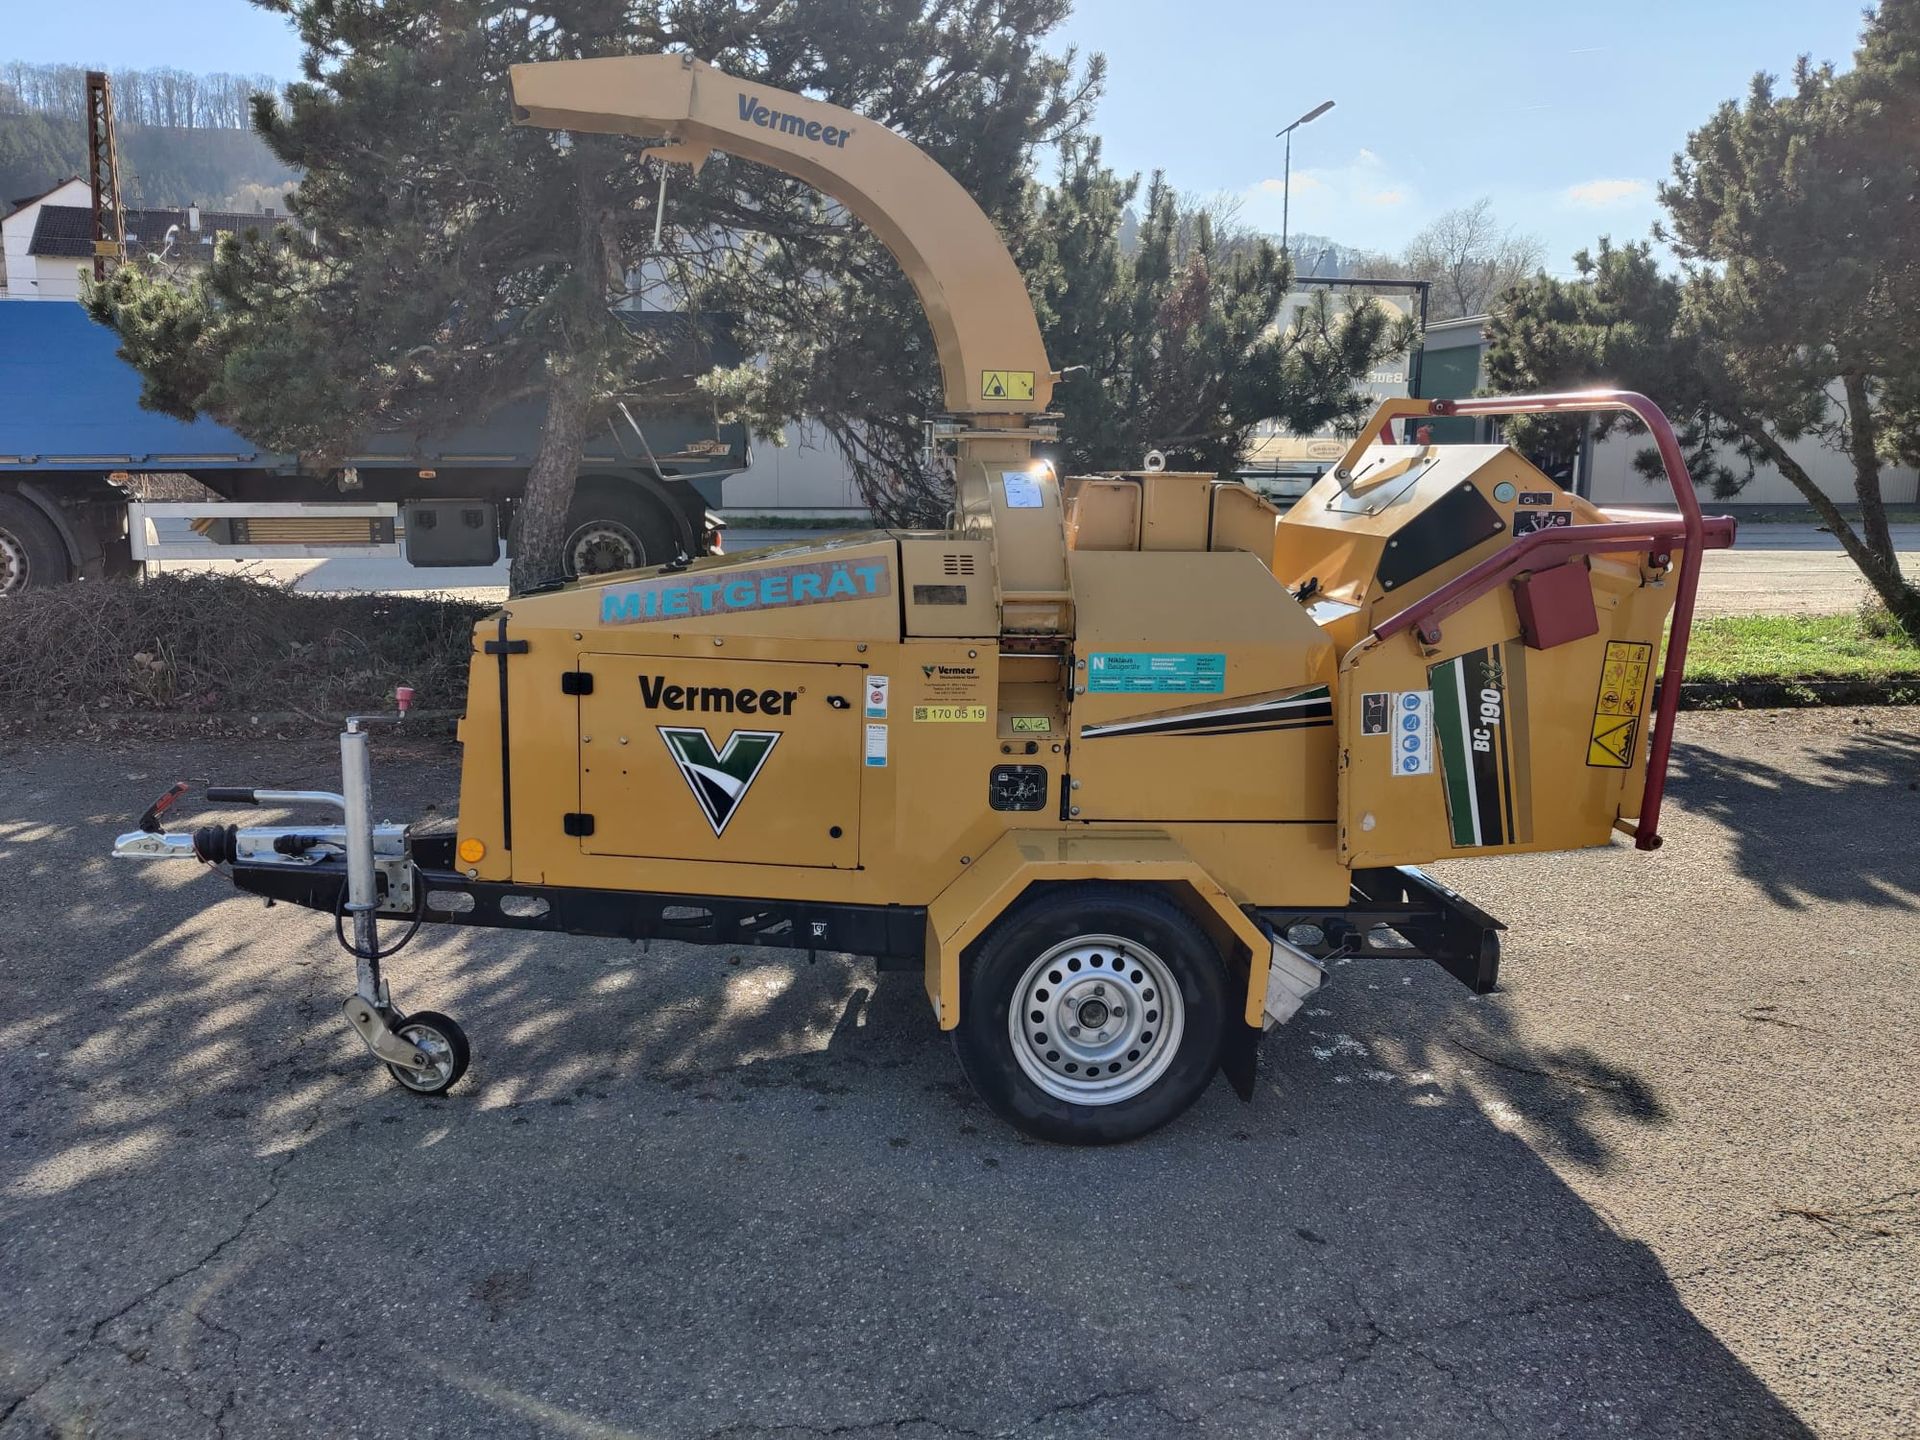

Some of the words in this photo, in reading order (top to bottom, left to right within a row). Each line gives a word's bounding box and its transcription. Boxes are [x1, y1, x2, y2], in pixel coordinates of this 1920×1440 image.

[738, 93, 851, 148] Vermeer
[602, 562, 884, 622] MIETGERÄT
[938, 665, 976, 675] Vermeer
[638, 675, 798, 716] Vermeer
[931, 709, 952, 719] 170
[954, 709, 968, 719] 05
[972, 709, 985, 719] 19
[1480, 688, 1501, 726] 190
[1473, 727, 1491, 753] BC
